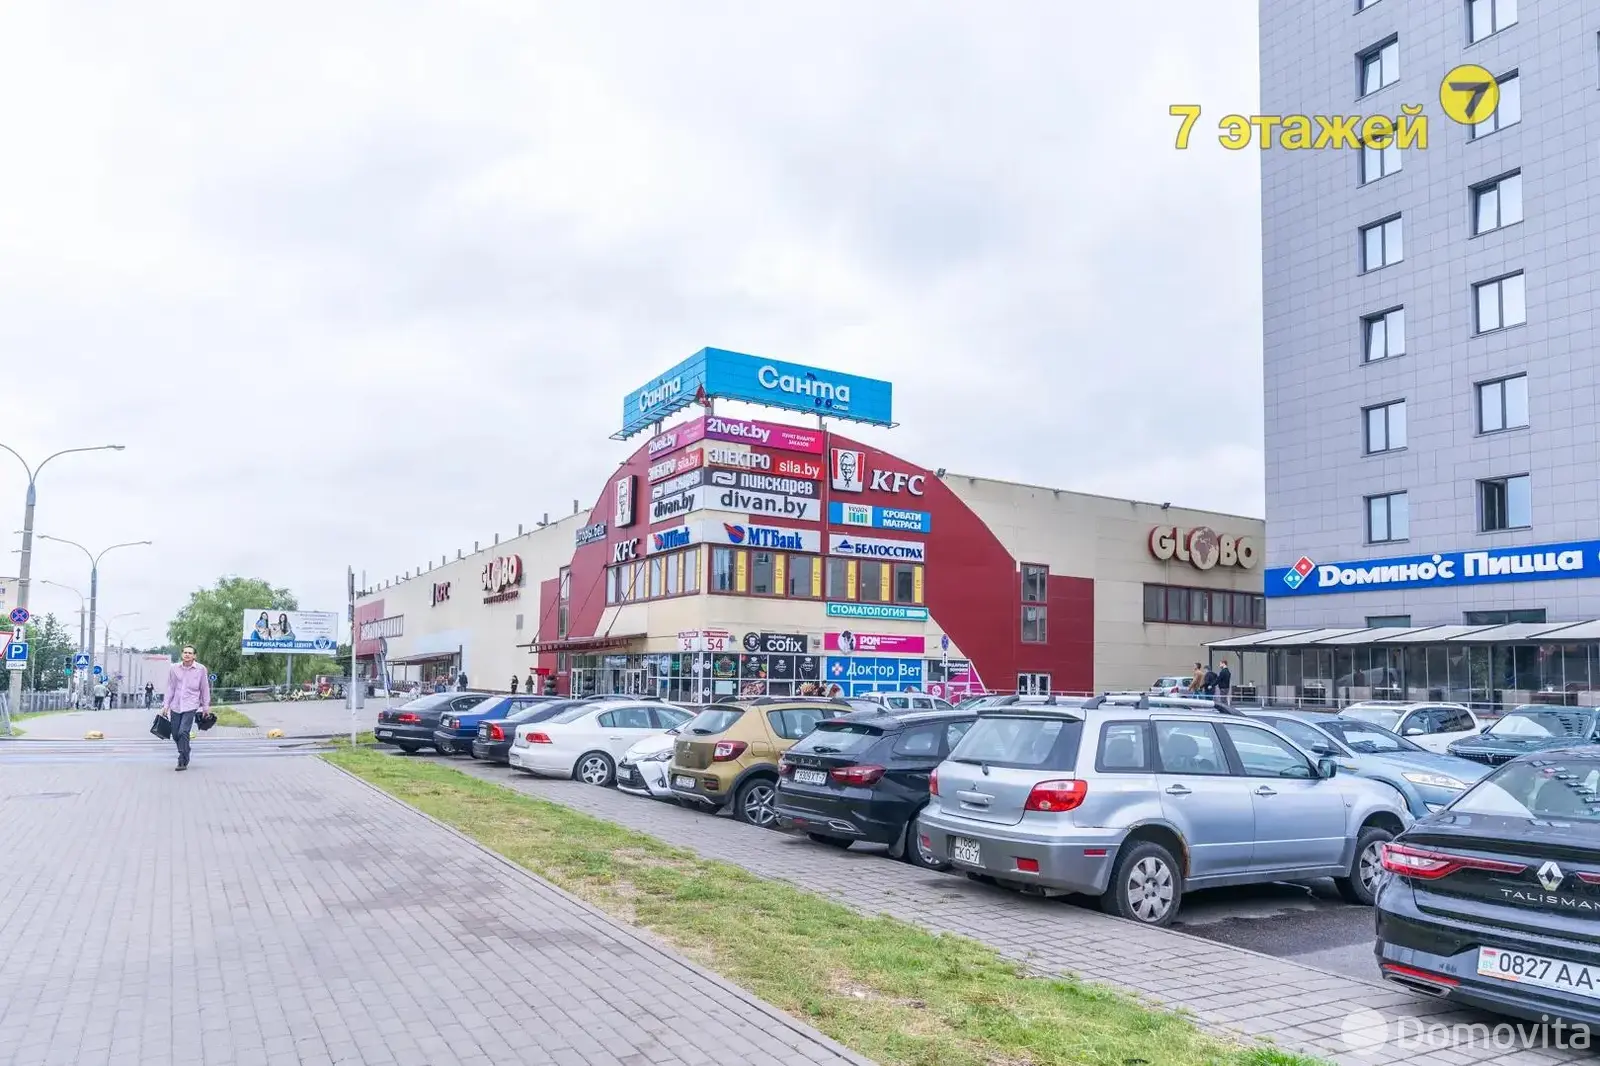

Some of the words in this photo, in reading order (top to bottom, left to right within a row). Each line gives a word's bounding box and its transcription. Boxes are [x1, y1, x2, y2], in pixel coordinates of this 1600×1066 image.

[757, 365, 850, 402] Санта
[707, 418, 771, 443] 21vek.by
[708, 447, 770, 470] ЭЛЕКТРО
[779, 459, 820, 479] sila.by
[869, 469, 926, 496] KFC
[653, 492, 695, 518] divan.by
[720, 490, 807, 518] divan.by
[882, 509, 922, 521] КРОВАТИ
[882, 518, 922, 530] МАТРАСЫ
[613, 538, 640, 562] KFC
[855, 543, 923, 559] БЕЛГОССТРАХ
[1148, 525, 1260, 570] GLOBO
[481, 553, 523, 594] GLOBO
[1463, 550, 1583, 577] Пицца
[831, 604, 905, 618] СТОМАТОЛОГИЯ
[12, 645, 23, 658] P
[707, 638, 724, 651] 54
[767, 638, 802, 652] cofix
[846, 662, 895, 678] Доктор
[900, 663, 921, 676] Вет
[1499, 952, 1552, 980] 0827
